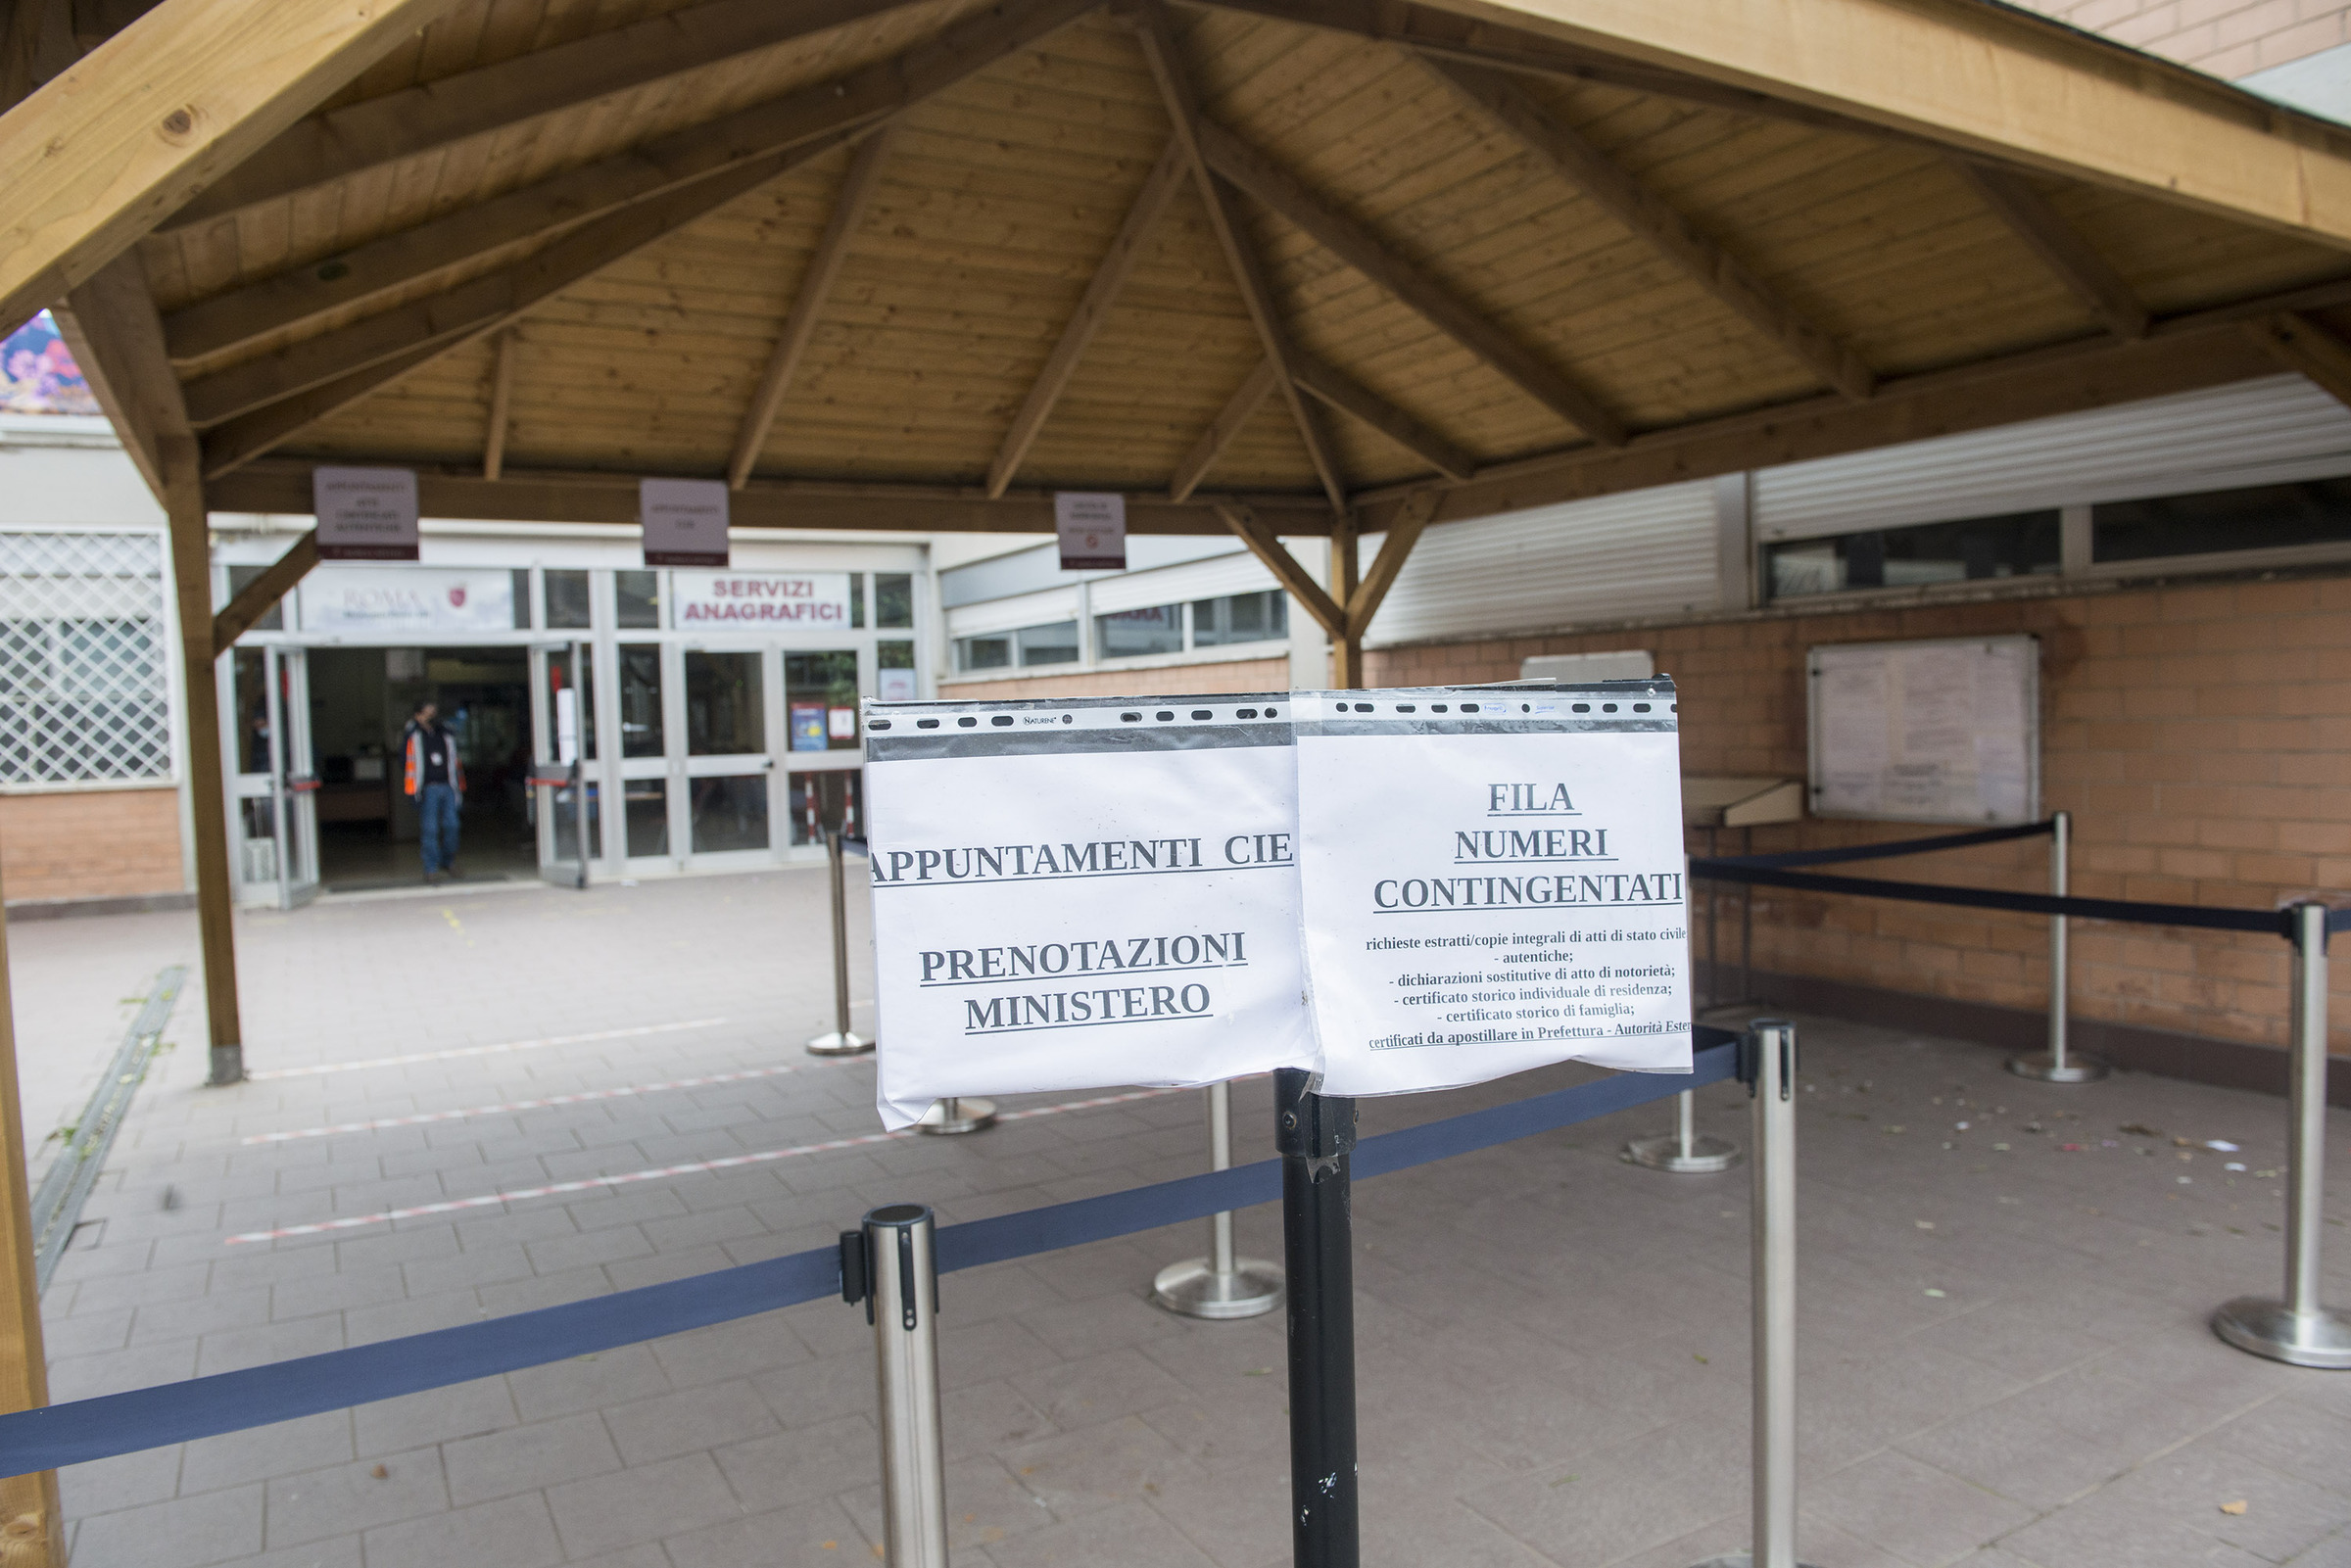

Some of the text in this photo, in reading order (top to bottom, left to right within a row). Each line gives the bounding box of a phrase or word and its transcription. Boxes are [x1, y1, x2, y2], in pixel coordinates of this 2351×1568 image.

[714, 580, 814, 596] SERVIZI
[686, 603, 842, 620] ANAGRAFICI
[1487, 783, 1575, 812] FILA
[1224, 833, 1294, 867] CIE
[1455, 829, 1608, 859] NUMERI
[1373, 873, 1682, 909] CONTINGENTATI
[1366, 936, 1420, 951] richieste
[1424, 933, 1509, 949] estratti/copie
[1511, 931, 1565, 947] integrali
[1569, 930, 1581, 943] di
[1585, 929, 1607, 942] atti
[1610, 929, 1622, 942] di
[1626, 929, 1656, 941] stato
[919, 931, 1247, 982] PRENOTAZIONI
[1503, 950, 1573, 964] autentiche;
[1398, 971, 1483, 987] dichiarazioni
[1486, 968, 1552, 982] sostitutive
[1555, 968, 1567, 980] di
[1570, 967, 1596, 979] atto
[1599, 966, 1611, 978] di
[1614, 965, 1676, 978] notorietà;
[964, 983, 1212, 1030] MINISTERO
[1402, 991, 1468, 1006] certificato
[1471, 988, 1516, 1003] storico
[1519, 985, 1591, 1000] individuale
[1594, 984, 1607, 997] di
[1609, 983, 1673, 996] residenza;
[1446, 1009, 1512, 1022] certificato
[1515, 1006, 1559, 1020] storico
[1563, 1005, 1576, 1017] di
[1579, 1002, 1635, 1019] famiglia;
[1368, 1032, 1423, 1049] certificati
[1427, 1031, 1444, 1045] da
[1447, 1028, 1518, 1046] apostillare
[1521, 1026, 1535, 1040] in
[1537, 1024, 1604, 1039] Prefettura
[1614, 1021, 1662, 1035] Autorità
